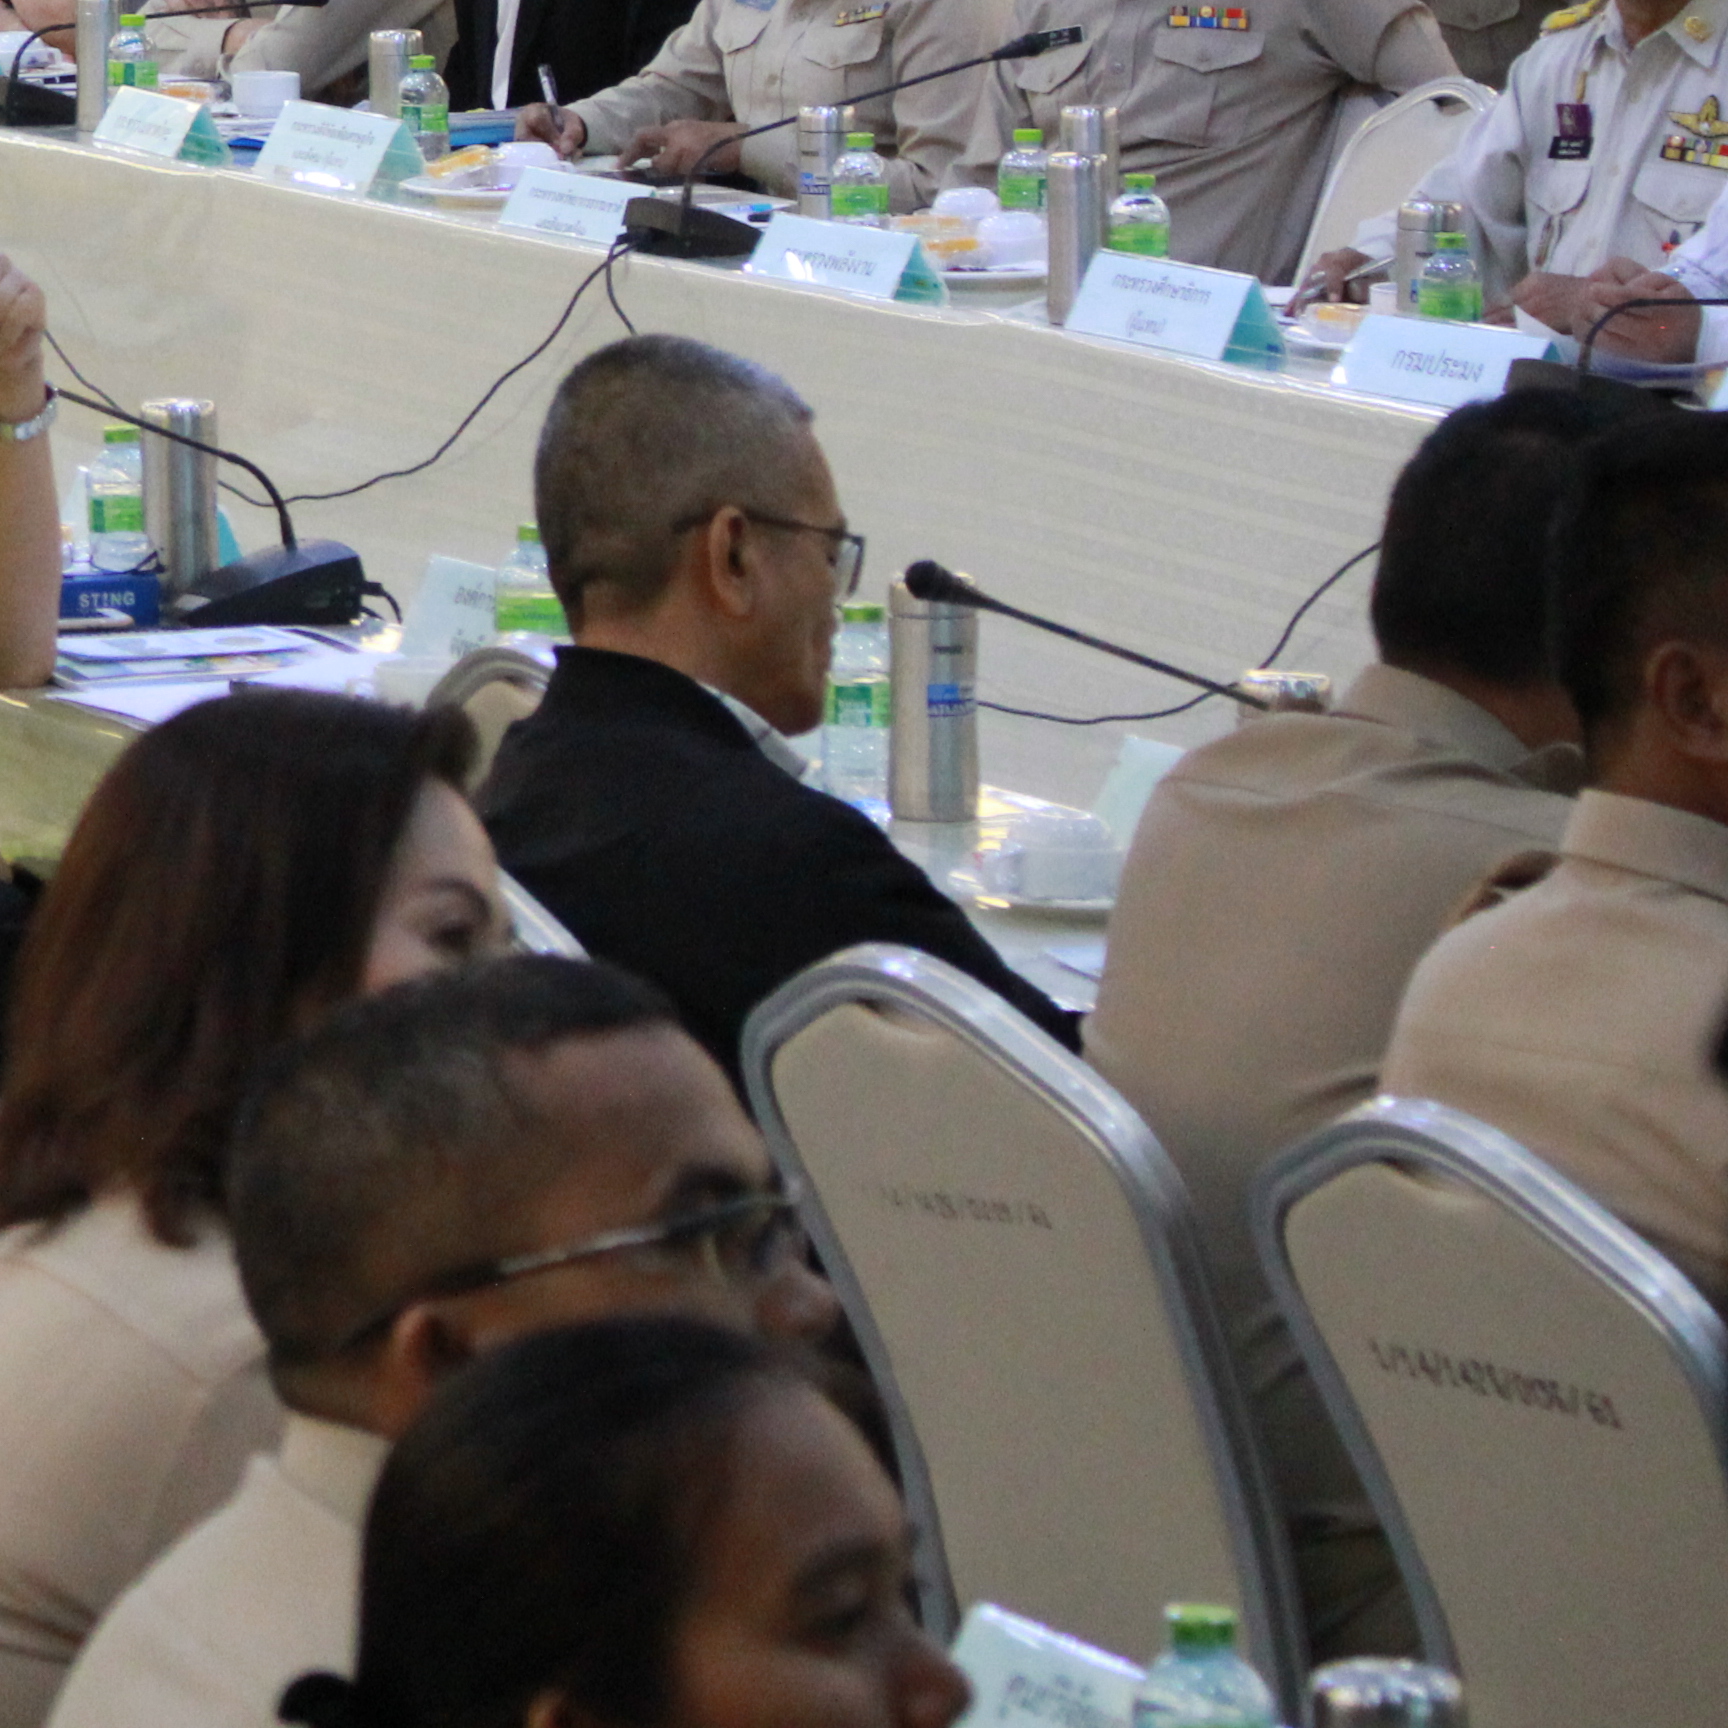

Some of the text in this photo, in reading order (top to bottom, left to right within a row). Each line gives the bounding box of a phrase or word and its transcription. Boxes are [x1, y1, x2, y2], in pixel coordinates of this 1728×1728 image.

[1111, 271, 1212, 304] กระทรวงศึกษาธิการ
[1390, 345, 1485, 383] กรมประมง
[78, 591, 136, 608] STING
